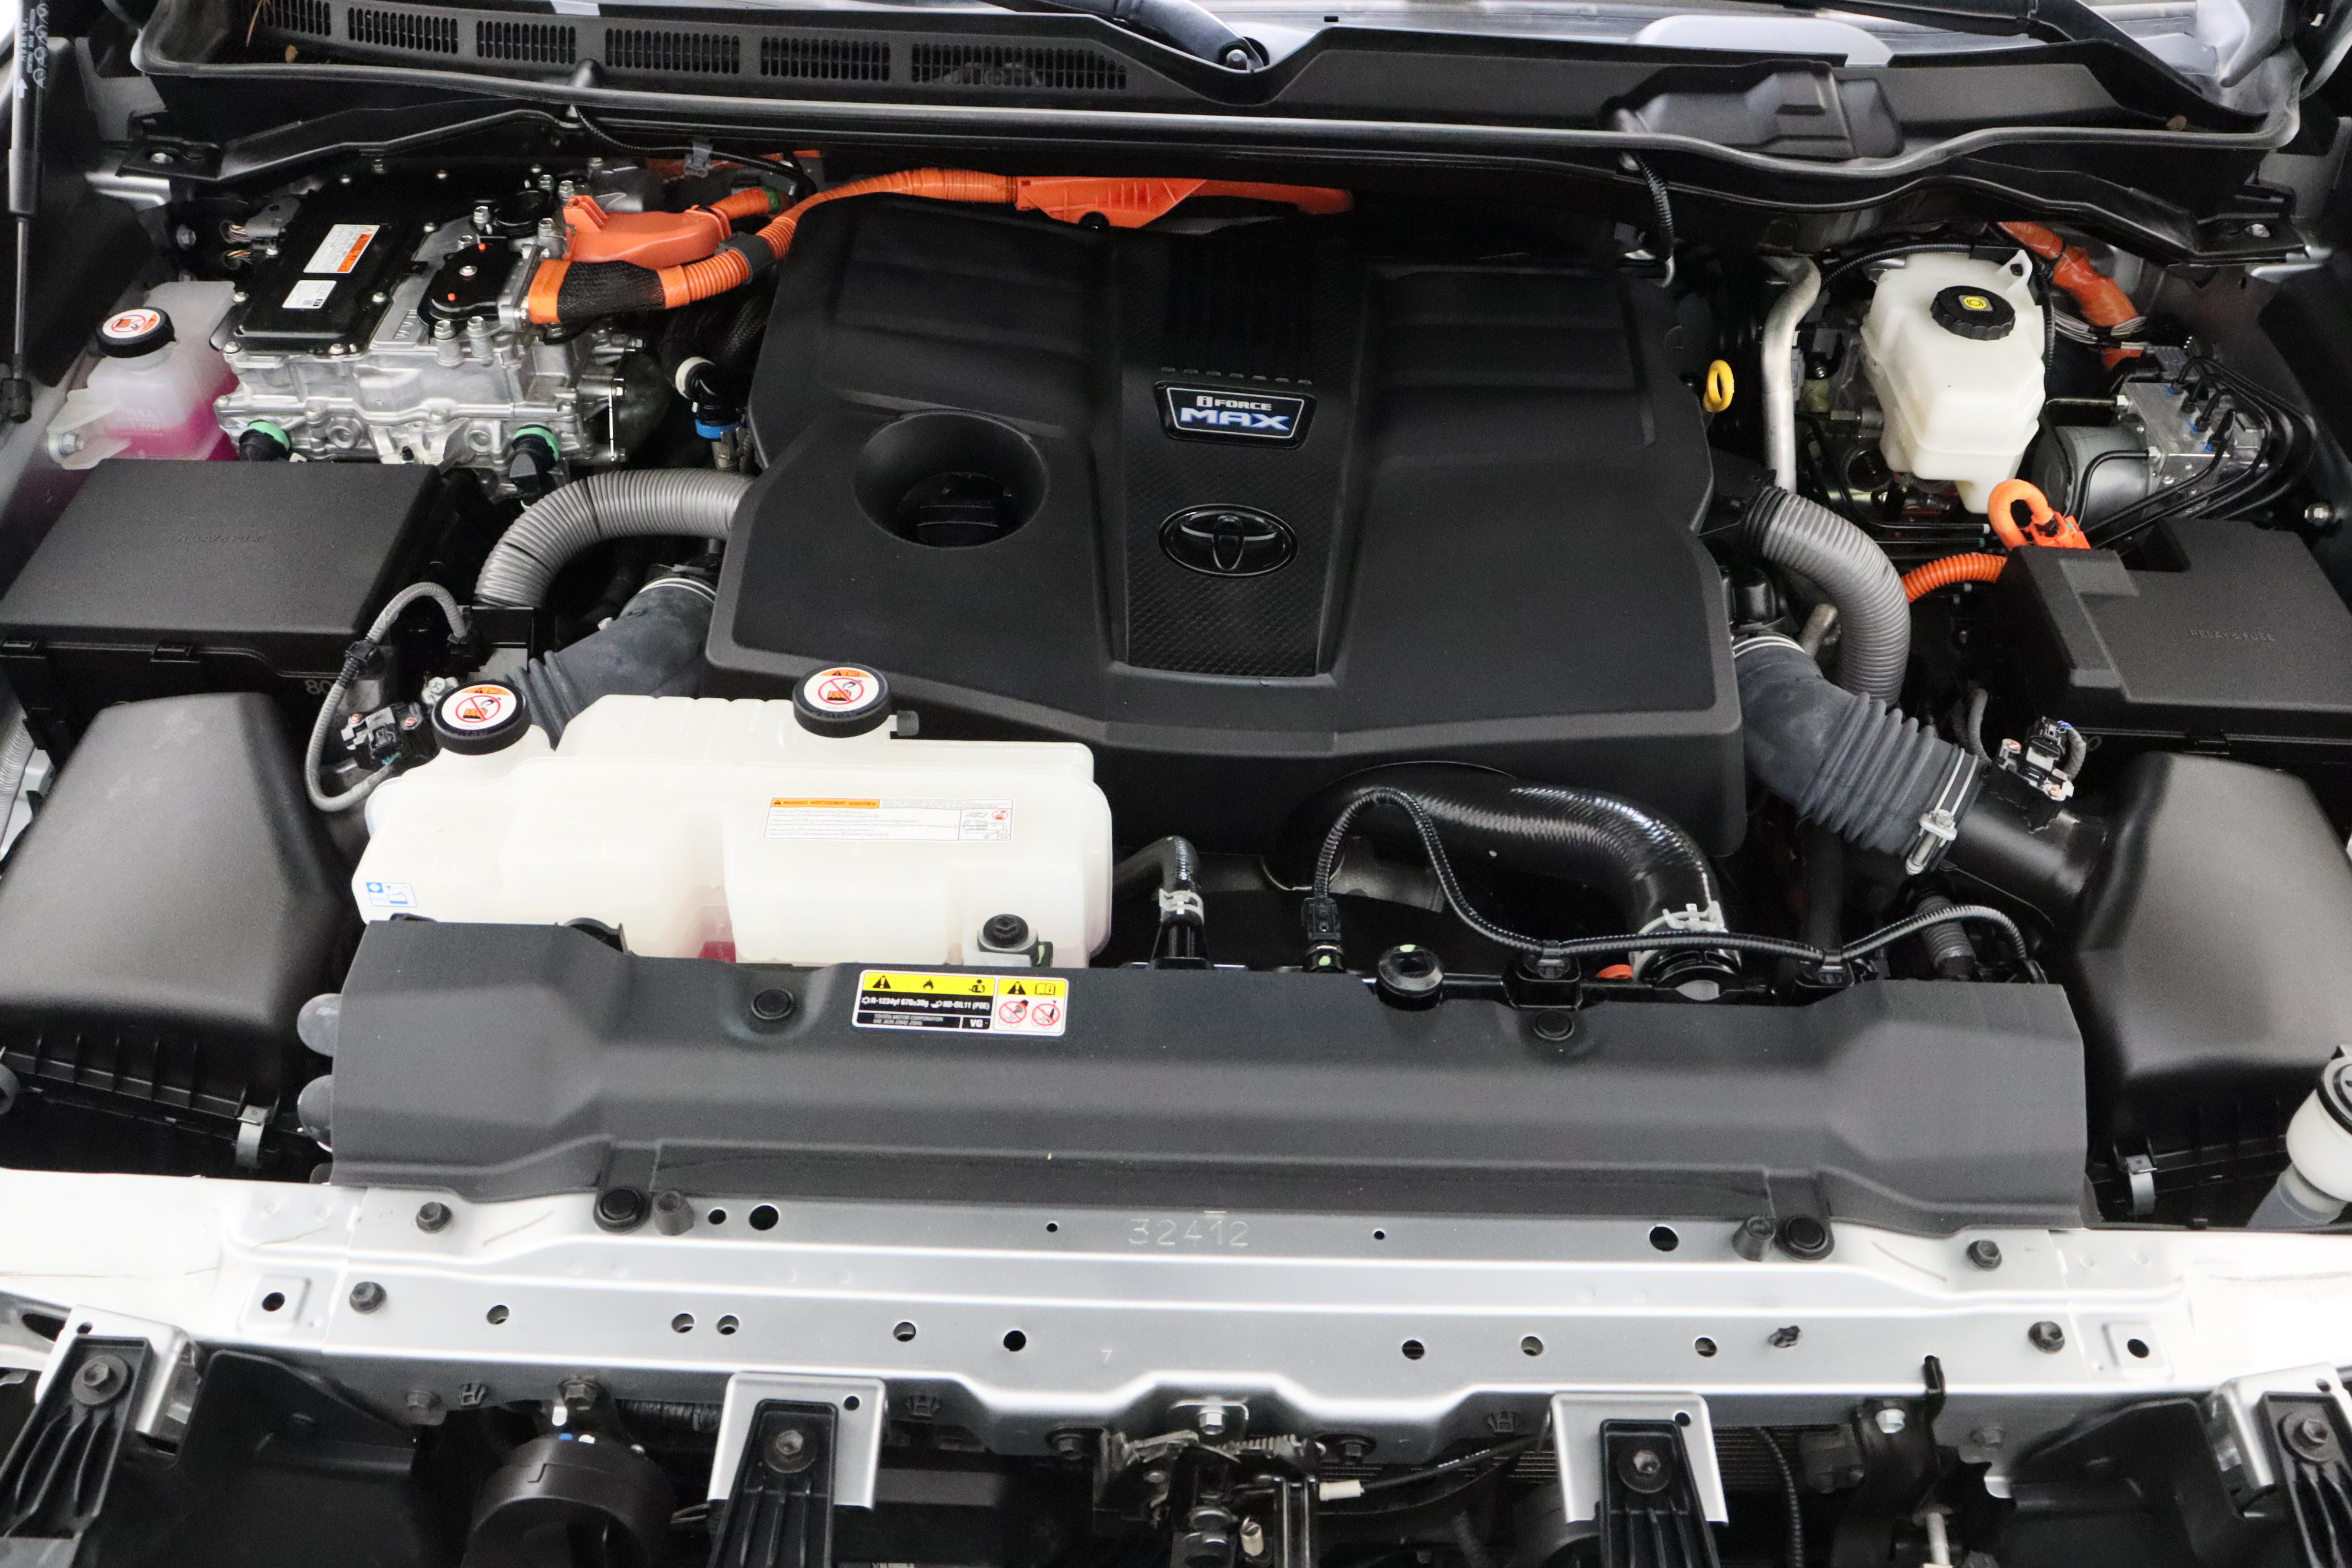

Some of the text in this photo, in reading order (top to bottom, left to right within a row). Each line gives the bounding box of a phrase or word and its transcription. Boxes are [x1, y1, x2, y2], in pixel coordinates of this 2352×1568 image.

[1214, 399, 1272, 411] FORCE
[1180, 407, 1290, 431] MAX
[970, 1019, 983, 1028] VG
[1128, 1219, 1249, 1246] 32412
